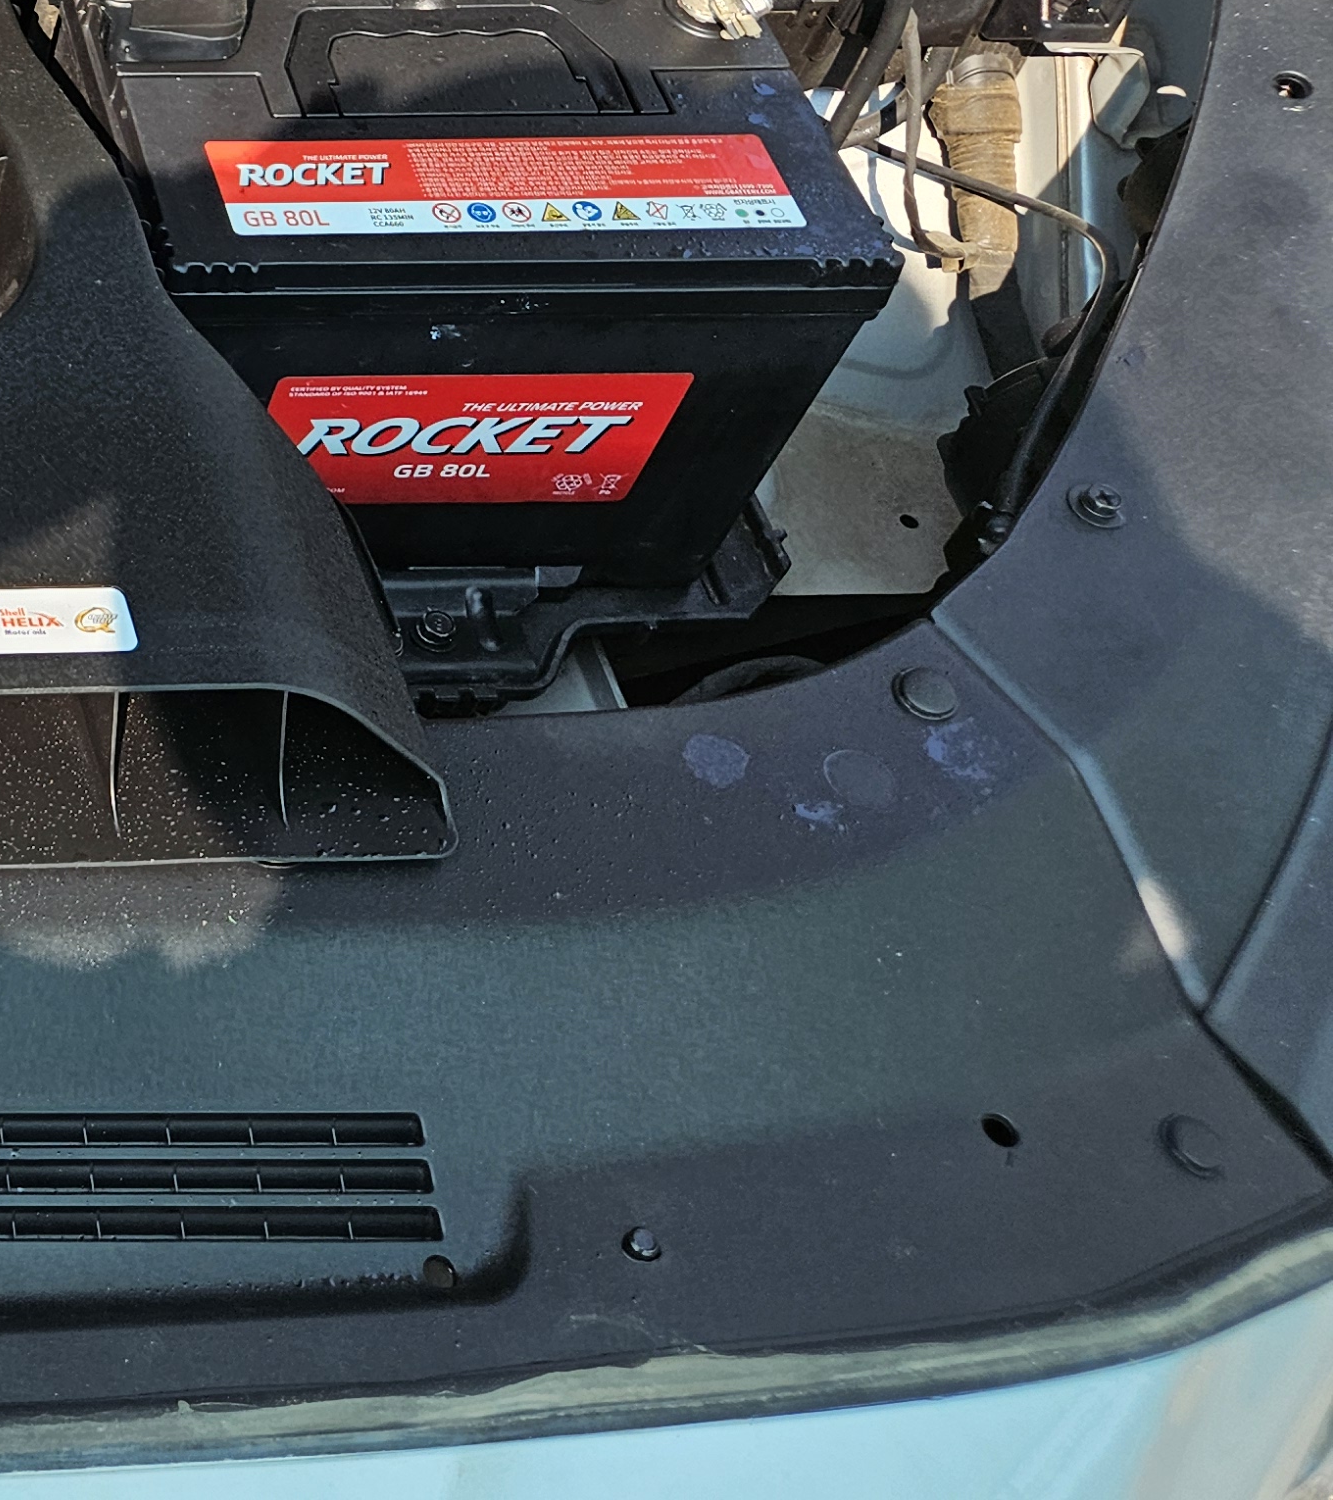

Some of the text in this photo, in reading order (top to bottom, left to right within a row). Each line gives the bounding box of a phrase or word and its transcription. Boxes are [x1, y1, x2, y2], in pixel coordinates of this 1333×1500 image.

[236, 161, 391, 187] ROCKET
[243, 209, 331, 228] GB 80L
[463, 401, 644, 412] THE ULTIMATE POWER
[296, 415, 634, 458] ROCKET
[392, 463, 491, 479] GB 80L
[0, 607, 26, 617] Shell
[2, 616, 65, 628] HELIX
